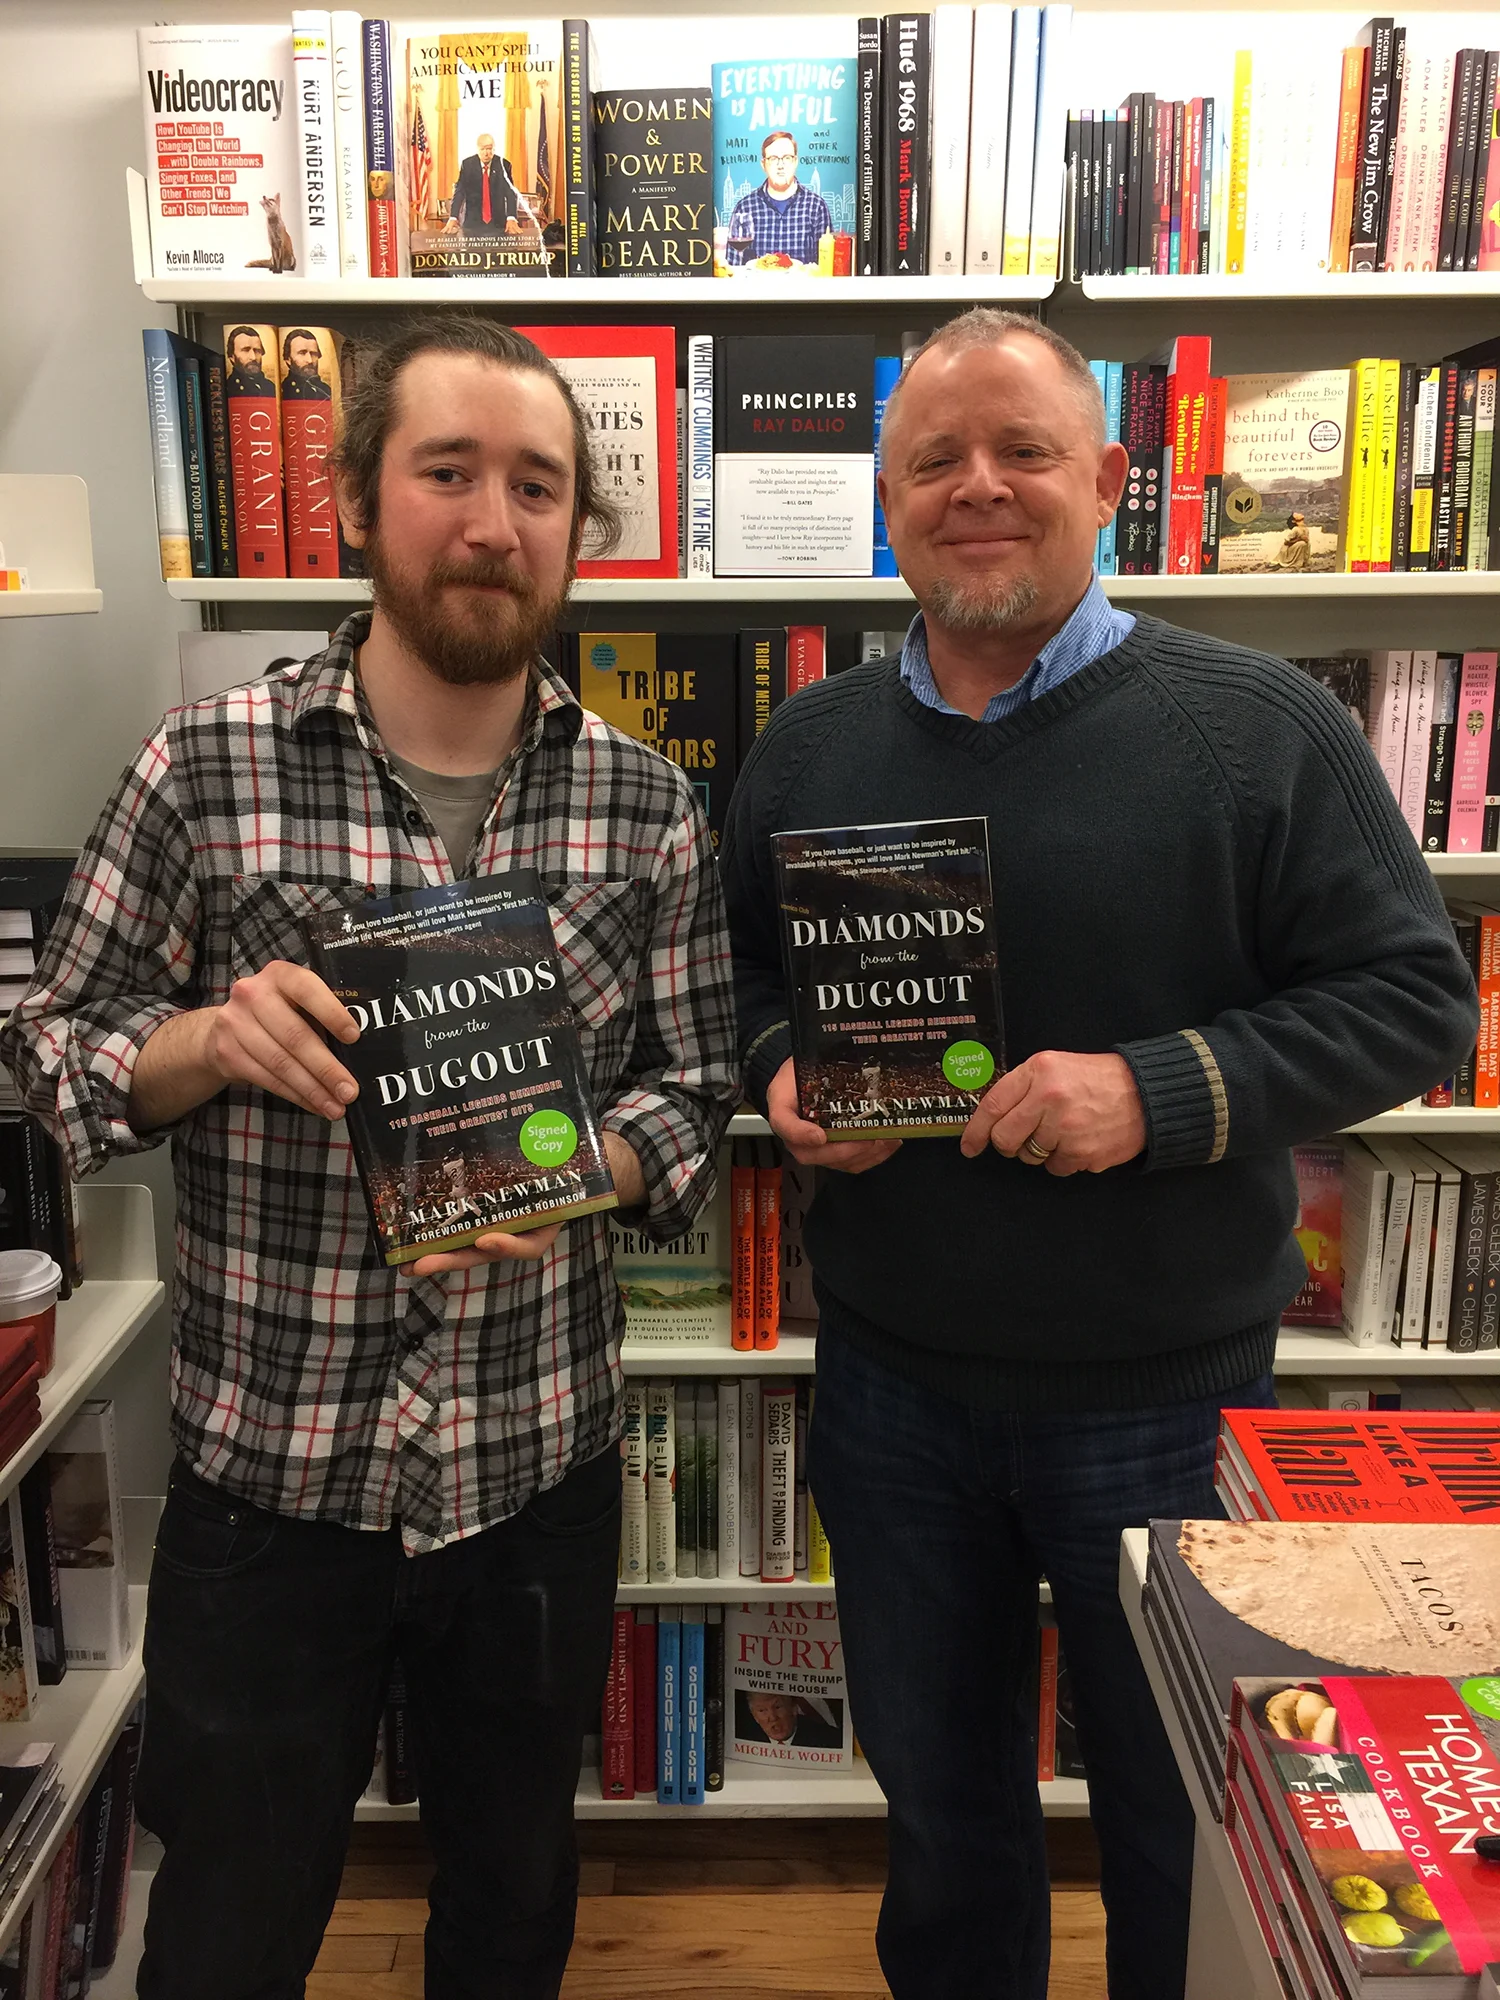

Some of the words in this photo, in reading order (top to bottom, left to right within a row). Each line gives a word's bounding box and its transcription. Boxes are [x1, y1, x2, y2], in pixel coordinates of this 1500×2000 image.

[421, 47, 451, 60] YOU
[455, 44, 498, 58] CAN'T
[571, 32, 579, 52] THE
[411, 62, 478, 78] AMERICA
[481, 60, 555, 74] WITHOUT
[571, 55, 581, 105] PRISONER
[720, 63, 846, 99] EVERYTHING
[863, 68, 873, 89] The
[148, 69, 286, 121] Videocracy
[303, 80, 321, 125] KURT
[463, 78, 501, 99] ME
[1371, 84, 1388, 116] The
[572, 110, 581, 121] IN
[597, 97, 712, 124] WOMEN
[731, 98, 746, 116] IS
[748, 93, 838, 131] AWFUL
[863, 91, 873, 151] Destruction
[898, 80, 916, 133] 1968
[157, 125, 174, 135] How
[178, 124, 210, 135] YouTube
[215, 124, 223, 135] Is
[372, 109, 386, 171] FAREWELL
[572, 125, 581, 143] HIS
[645, 129, 662, 145] &
[1368, 119, 1384, 157] New
[158, 140, 193, 153] Changing
[198, 140, 211, 151] the
[215, 139, 239, 151] World
[193, 156, 219, 167] Double
[222, 155, 262, 168] Rainbows,
[863, 153, 873, 165] of
[900, 139, 912, 183] Mark
[161, 173, 188, 185] Singing
[190, 172, 216, 183] Foxes,
[221, 172, 235, 182] and
[305, 133, 325, 226] ANDERSEN
[572, 146, 582, 183] PALACE
[604, 152, 707, 176] POWER
[1364, 155, 1381, 187] Jim
[161, 189, 183, 199] Other
[184, 188, 211, 199] Trends
[216, 188, 229, 198] We
[861, 167, 874, 201] Hillary
[163, 205, 183, 215] Can't
[188, 204, 206, 216] Stop
[210, 204, 248, 216] Watching
[605, 203, 705, 233] MARY
[863, 202, 873, 242] Clinton
[898, 188, 911, 251] Bowden
[1361, 190, 1379, 234] Crow
[166, 250, 190, 265] Kevin
[193, 249, 225, 264] Allocca
[415, 252, 481, 268] DONALD
[484, 253, 495, 269] J.
[499, 252, 556, 266] TRUMP
[601, 239, 712, 268] BEARD
[693, 342, 713, 403] WHITNEY
[741, 392, 858, 410] PRINCIPLES
[1266, 388, 1319, 399] Katherine
[1324, 387, 1344, 397] Boo
[1427, 382, 1436, 415] Kitchen
[152, 356, 176, 469] Nomadland
[753, 419, 785, 433] RAY
[791, 418, 846, 433] DALIO
[1191, 391, 1205, 453] Witness
[1233, 408, 1287, 423] behind
[1295, 408, 1320, 421] the
[692, 406, 712, 481] CUMMINGS
[1175, 393, 1190, 475] Revolution
[1423, 420, 1434, 473] Confidential
[1249, 448, 1313, 462] forevers
[190, 464, 200, 483] BAD
[248, 411, 279, 536] GRANT
[303, 414, 332, 539] GRANT
[191, 485, 202, 511] FOOD
[217, 480, 227, 516] HEATHER
[692, 498, 711, 519] I'M
[193, 513, 204, 541] BIBLE
[220, 519, 230, 551] CHAPLIN
[692, 521, 711, 552] FINE
[755, 641, 769, 671] TRIBE
[617, 670, 696, 700] TRIBE
[755, 674, 769, 687] OF
[643, 708, 669, 731] OF
[1428, 800, 1444, 808] Teju
[1428, 807, 1443, 815] Cole
[351, 922, 365, 933] you
[367, 919, 381, 929] love
[382, 913, 414, 925] baseball,
[424, 906, 438, 916] just
[439, 903, 455, 913] want
[456, 900, 463, 908] to
[465, 898, 474, 907] be
[475, 893, 502, 906] inspired
[503, 890, 512, 900] by
[791, 906, 985, 947] DIAMONDS
[860, 952, 894, 969] from
[895, 950, 919, 961] the
[343, 960, 556, 1034] DIAMONDS
[816, 975, 972, 1011] DUGOUT
[425, 1024, 463, 1050] from
[465, 1019, 490, 1033] the
[375, 1036, 552, 1106] DUGOUT
[948, 1051, 985, 1065] Signed
[955, 1065, 982, 1077] Copy
[389, 1119, 407, 1130] 115
[410, 1105, 460, 1126] BASEBALL
[463, 1094, 507, 1112] LEGENDS
[510, 1080, 563, 1100] REMEMBER
[426, 1123, 457, 1138] THEIR
[460, 1112, 509, 1130] GREATEST
[512, 1103, 535, 1116] HITS
[528, 1123, 567, 1138] Signed
[533, 1140, 563, 1153] Copy
[409, 1198, 475, 1225] MARK
[483, 1170, 583, 1207] NEWMAN
[1470, 1180, 1487, 1225] JAMES
[415, 1221, 471, 1243] FOREWORD
[475, 1216, 489, 1227] BY
[492, 1206, 532, 1223] BROOKS
[535, 1191, 586, 1212] ROBINSON
[1466, 1227, 1483, 1277] GLEICK
[1459, 1297, 1476, 1347] CHAOS
[768, 1403, 780, 1446] SEDARIS
[781, 1402, 791, 1445] DAVID
[773, 1449, 787, 1491] THEFT
[1365, 1424, 1417, 1469] LIKE
[1403, 1473, 1429, 1489] A
[772, 1499, 786, 1546] FINDING
[1400, 1557, 1464, 1635] TACOS
[767, 1620, 808, 1636] AND
[737, 1633, 842, 1671] FURY
[734, 1666, 772, 1679] INSIDE
[777, 1671, 798, 1682] THE
[802, 1674, 843, 1684] TRUMP
[748, 1680, 784, 1692] WHITE
[789, 1684, 828, 1695] HOUSE
[664, 1665, 673, 1782] SOONISH
[734, 1743, 795, 1760] MICHAEL
[797, 1751, 844, 1763] WOLFF
[1291, 1781, 1327, 1829] FAIN
[1315, 1782, 1351, 1829] LISA
[1358, 1737, 1443, 1878] COOKBOOK
[1398, 1745, 1480, 1854] TEXAN
